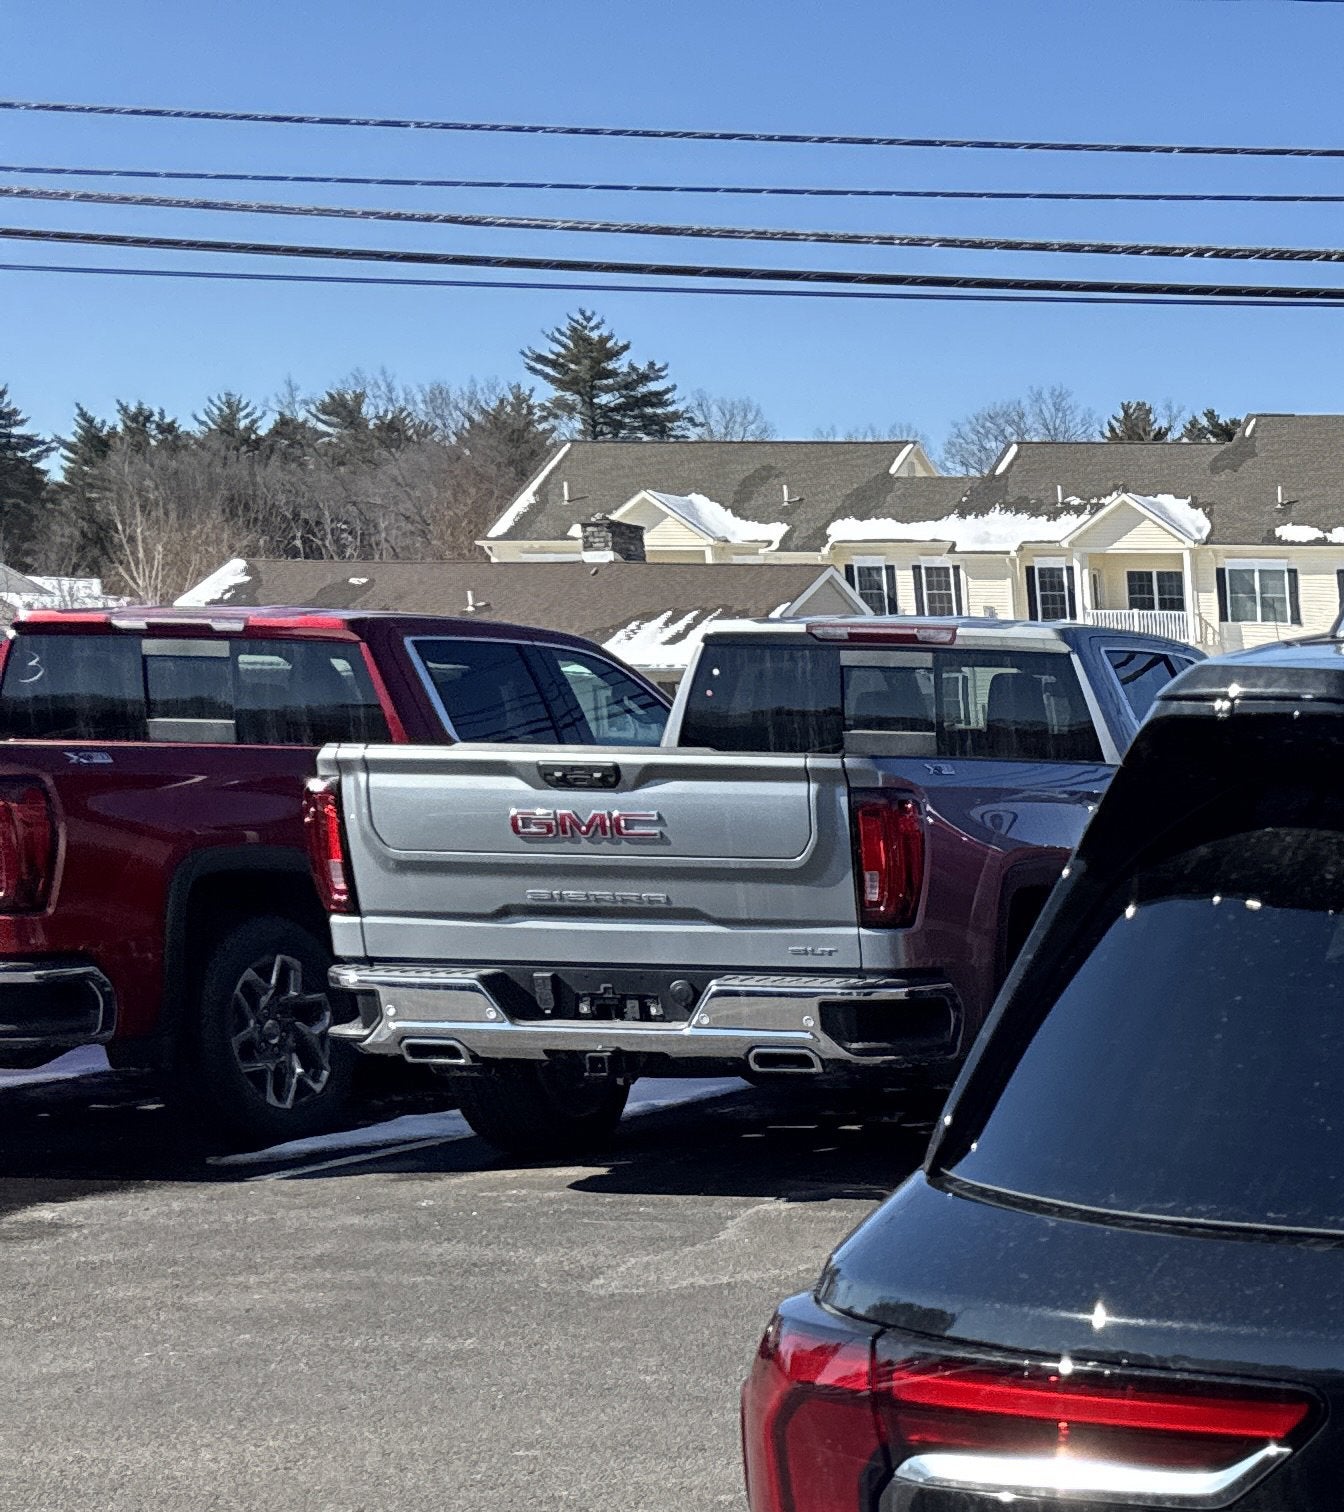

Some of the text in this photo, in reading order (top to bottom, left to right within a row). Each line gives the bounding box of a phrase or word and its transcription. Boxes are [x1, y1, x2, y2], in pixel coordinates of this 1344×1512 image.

[509, 808, 661, 839] GMC
[526, 890, 667, 904] SIERRA
[788, 946, 838, 956] SLT
